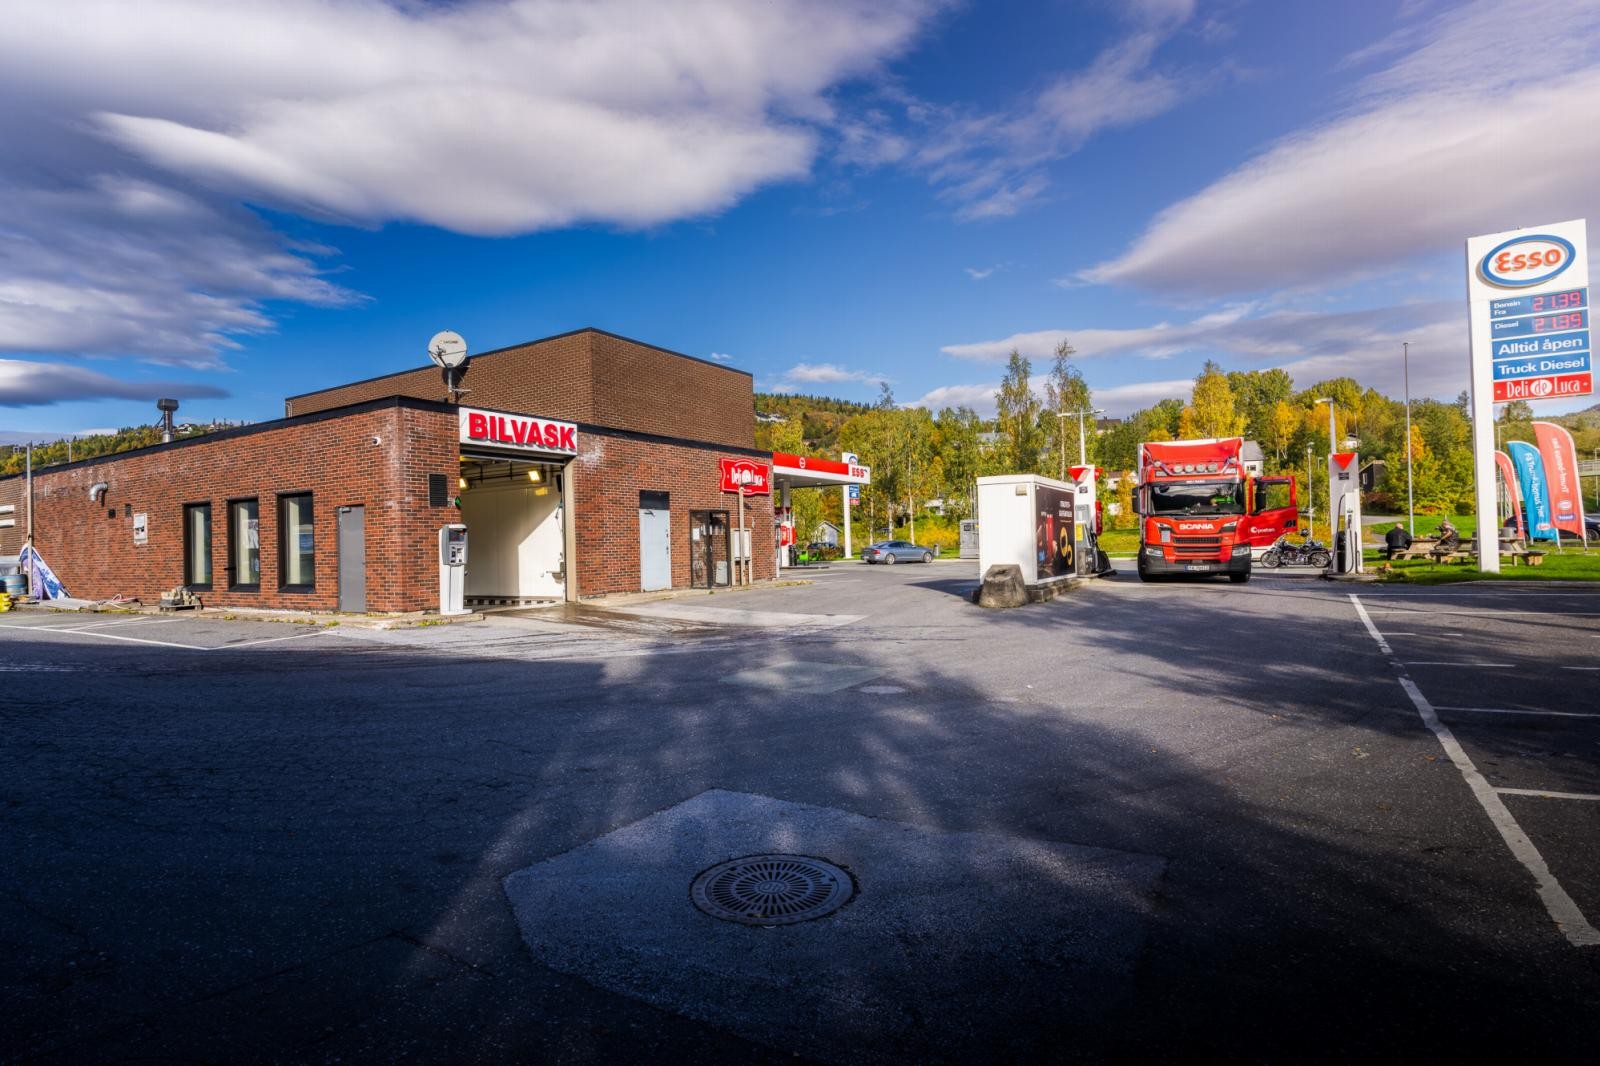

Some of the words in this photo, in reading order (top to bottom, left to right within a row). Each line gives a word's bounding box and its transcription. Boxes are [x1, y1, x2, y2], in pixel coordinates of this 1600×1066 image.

[1496, 249, 1561, 272] Esso
[1494, 301, 1521, 309] Bensin
[1494, 321, 1519, 330] Diesel
[1498, 340, 1539, 355] Alltid
[1542, 338, 1583, 352] åpen
[1498, 362, 1537, 375] Truck
[1540, 356, 1585, 371] Diesel
[1507, 380, 1529, 398] Deli
[1554, 376, 1580, 394] Luca
[468, 412, 576, 450] BILVASK
